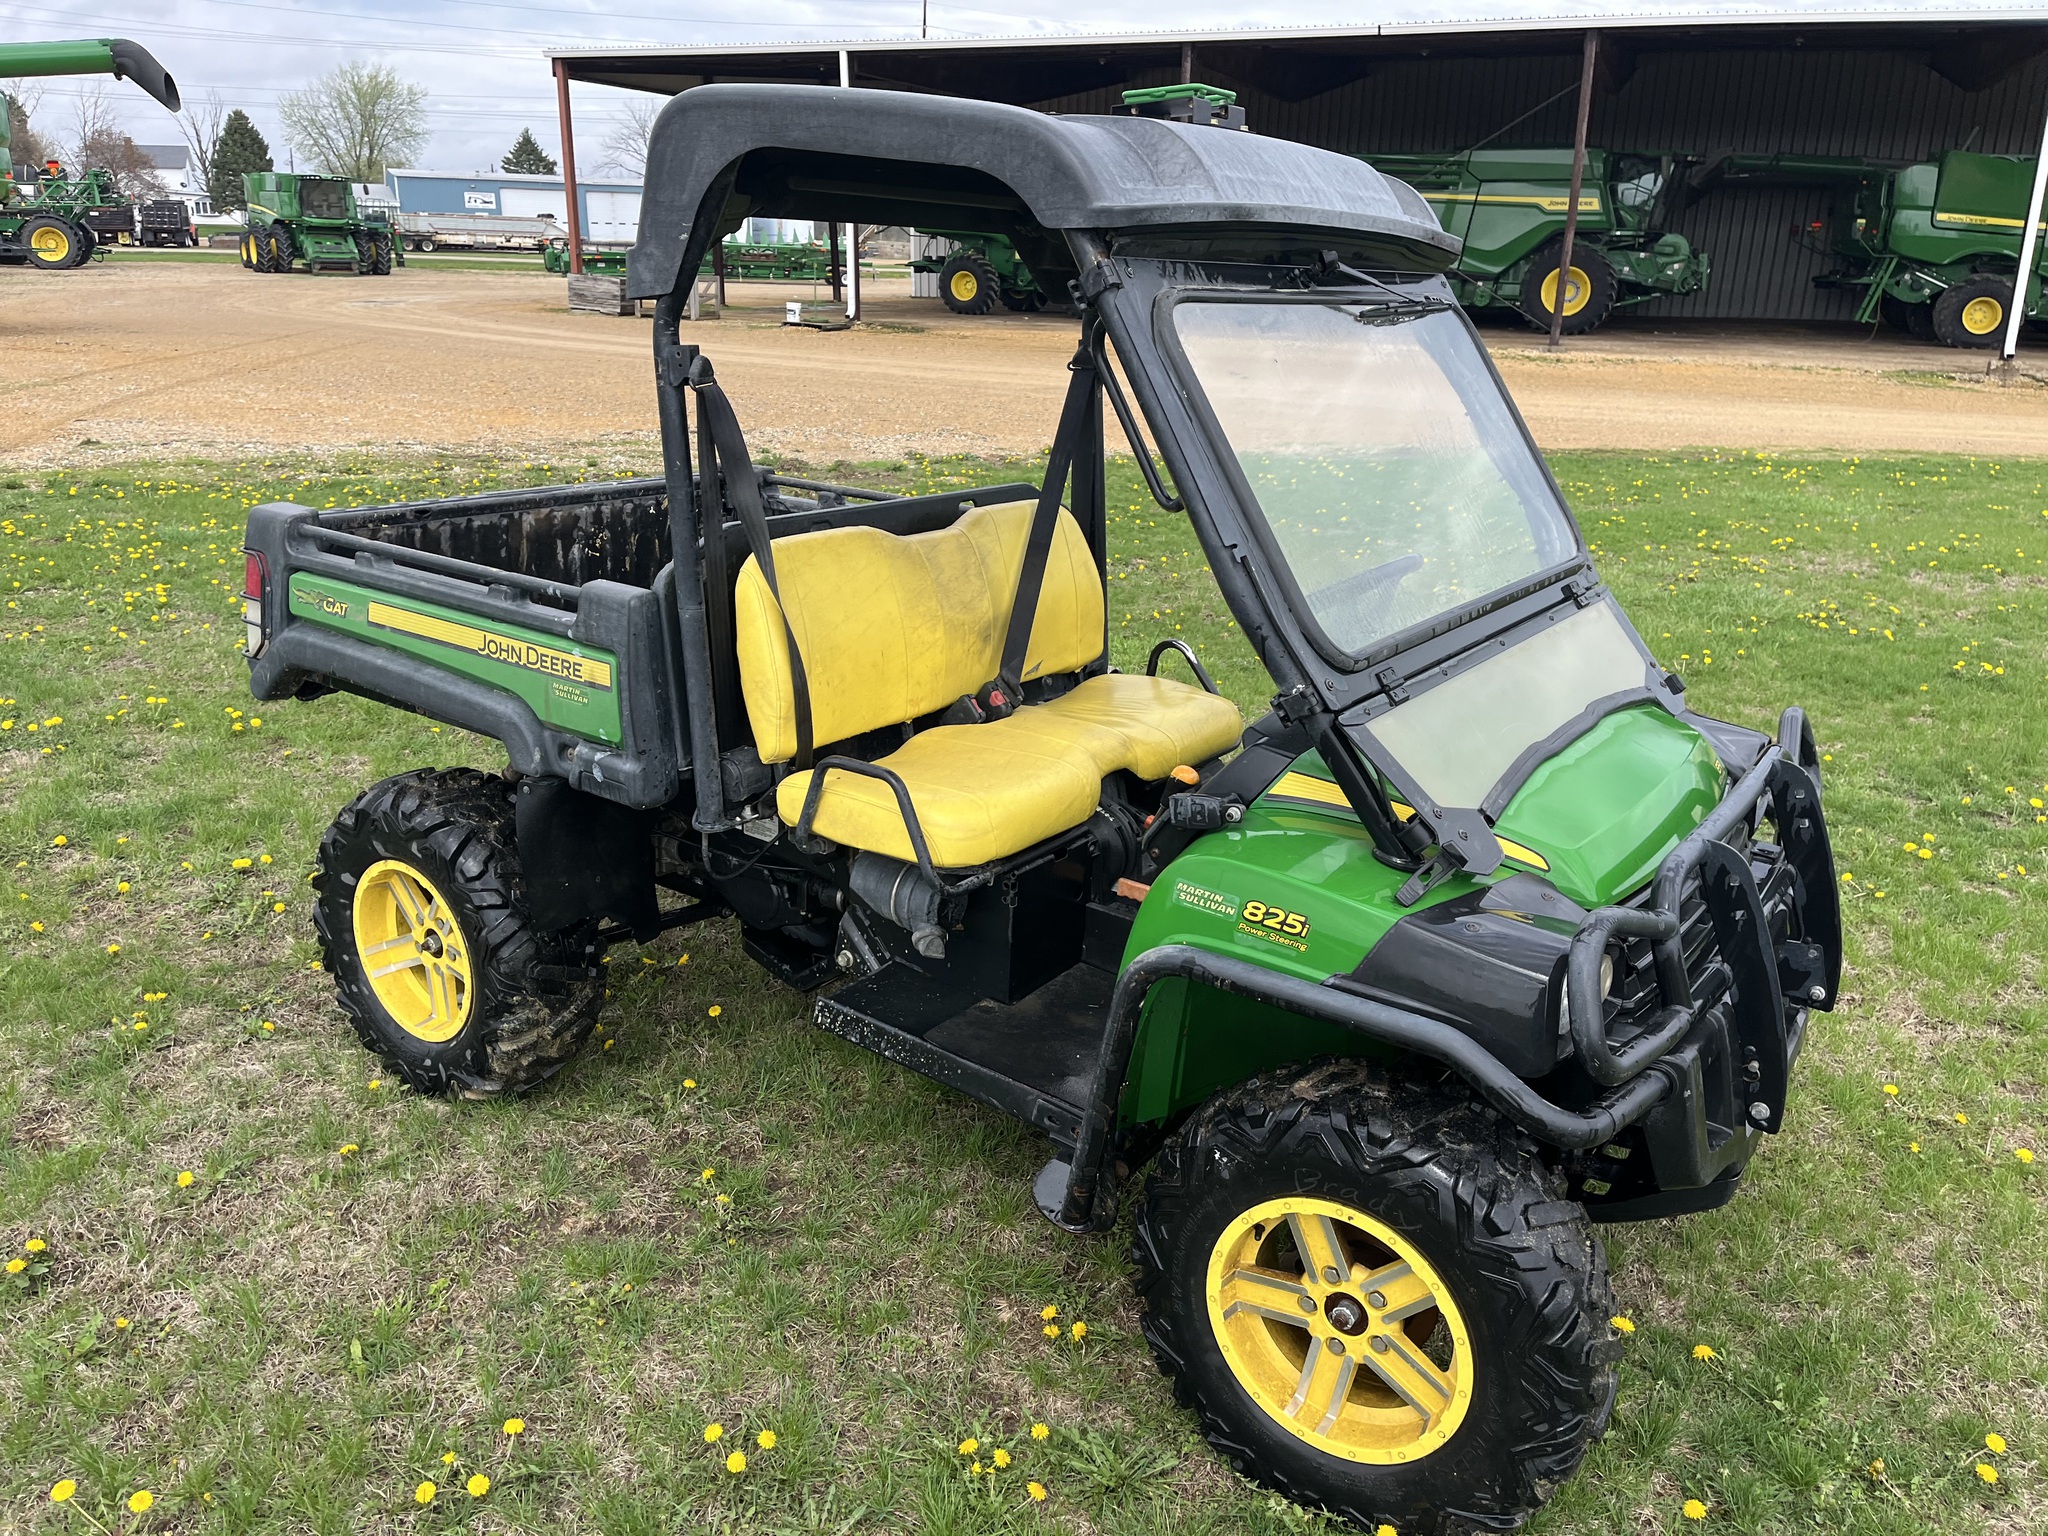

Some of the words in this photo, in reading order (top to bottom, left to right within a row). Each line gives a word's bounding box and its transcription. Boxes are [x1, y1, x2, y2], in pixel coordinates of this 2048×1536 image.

[477, 634, 523, 665] JOHN
[526, 645, 584, 681] DEERE
[552, 682, 581, 694] MARTIN
[555, 689, 589, 704] SULLIVAN
[1176, 882, 1224, 902] MARTIN
[1178, 892, 1236, 916] SULLIVAN
[1242, 900, 1311, 939] 825i
[1238, 922, 1268, 938] Power
[1268, 932, 1309, 952] Steering
